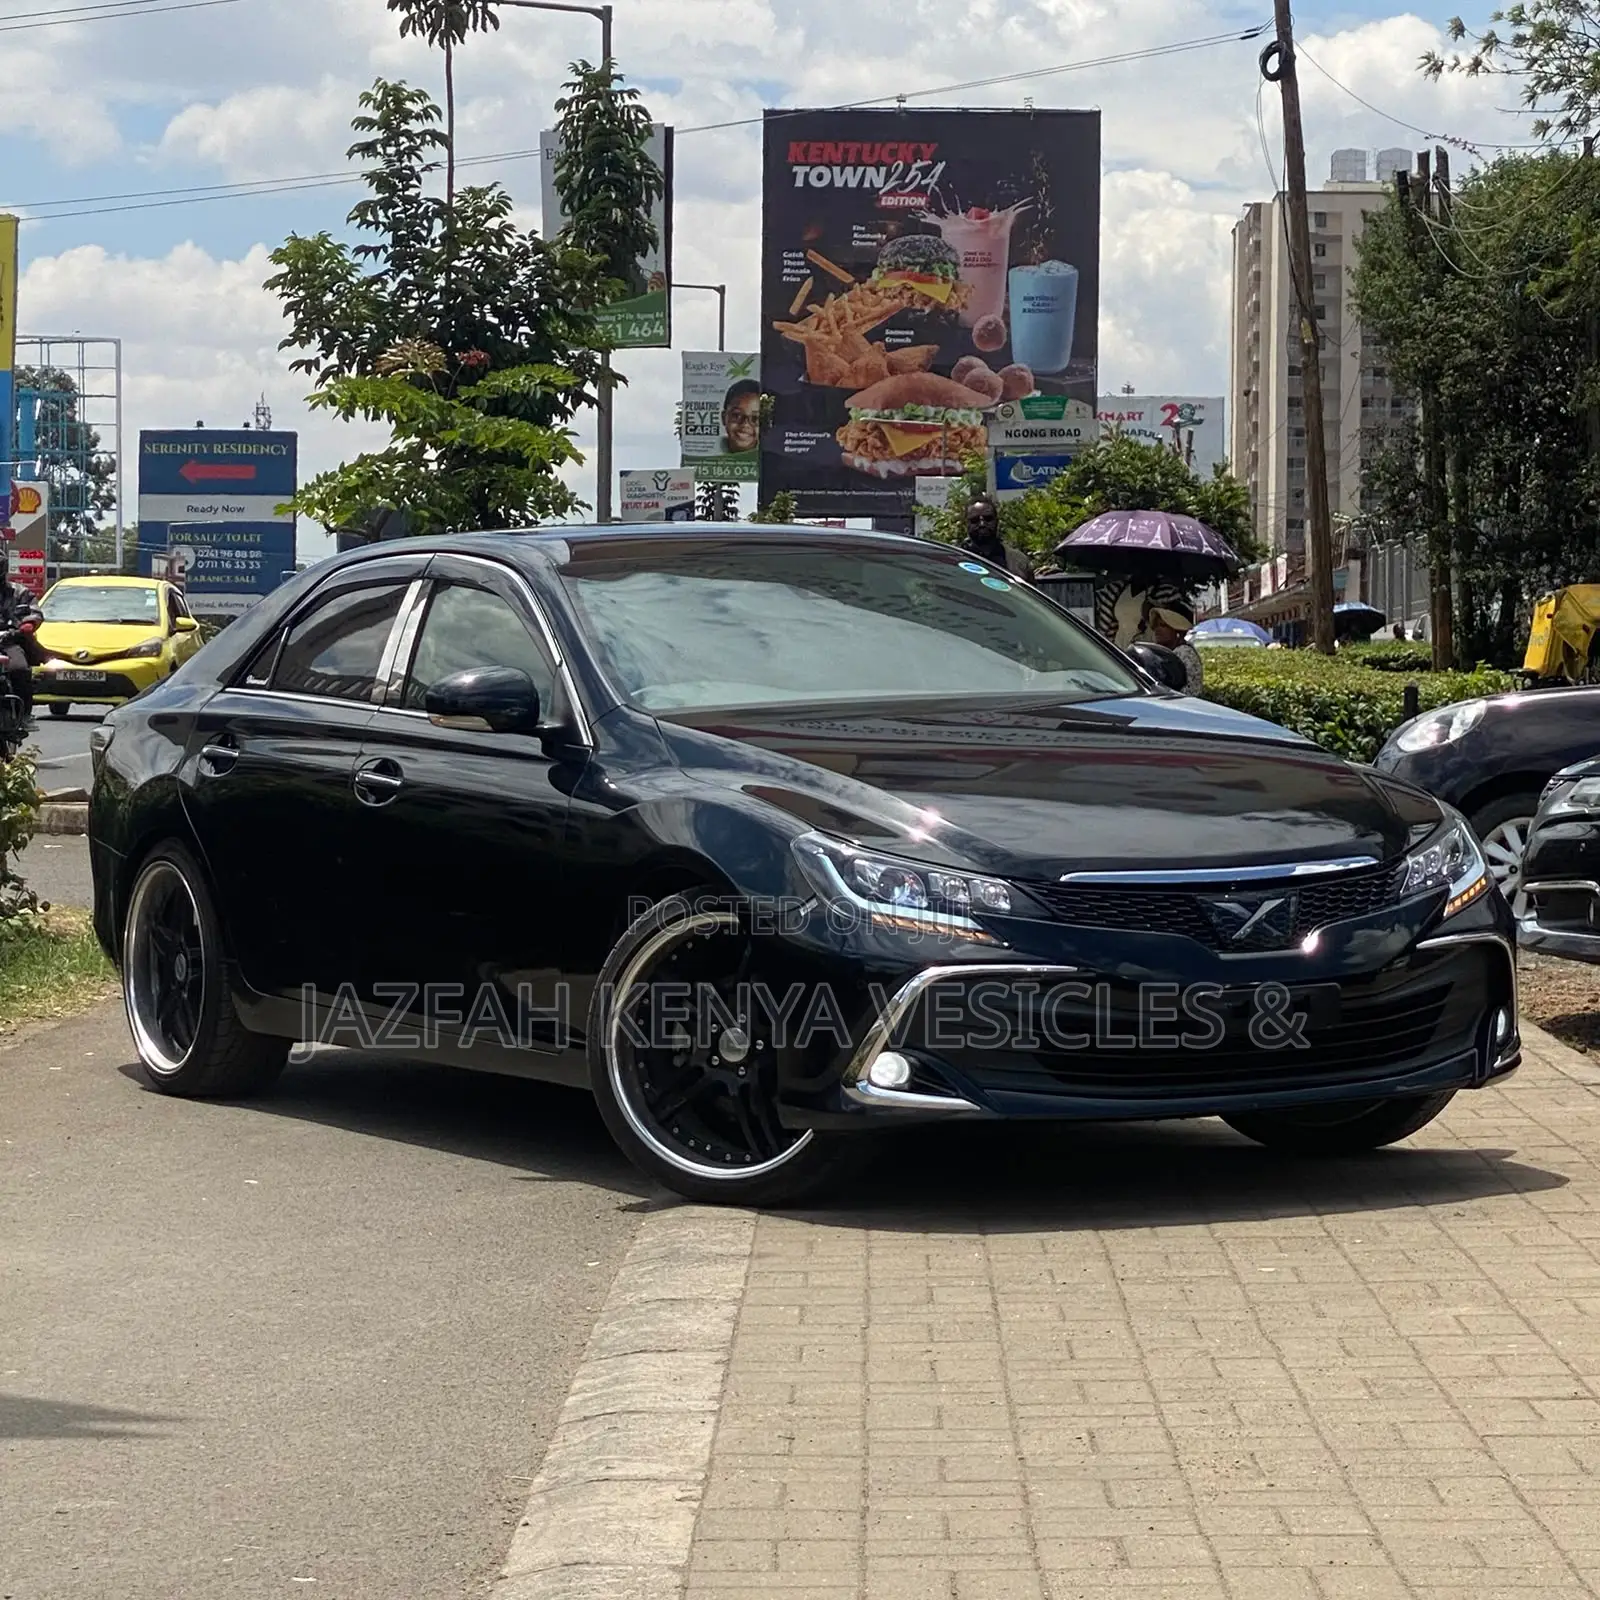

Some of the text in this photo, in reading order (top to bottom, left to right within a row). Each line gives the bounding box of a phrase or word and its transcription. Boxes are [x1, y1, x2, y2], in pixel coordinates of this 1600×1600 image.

[788, 141, 938, 164] KENTUCKY
[792, 159, 946, 195] TOWN 254
[881, 195, 926, 206] EDITION
[628, 320, 664, 338] 464
[685, 401, 720, 411] PEDIATRIC
[685, 412, 720, 425] EYE
[687, 426, 718, 436] CARE
[1005, 428, 1081, 439] NGONG ROAD
[144, 442, 289, 456] SERENITY RESIDENCY
[712, 466, 730, 476] 186
[734, 466, 758, 477] 034
[187, 504, 245, 515] Ready Now
[170, 532, 193, 542] FOR
[243, 533, 263, 542] LET
[197, 560, 261, 569] 0711 16 33 33
[187, 575, 256, 584] EARANCE SALE
